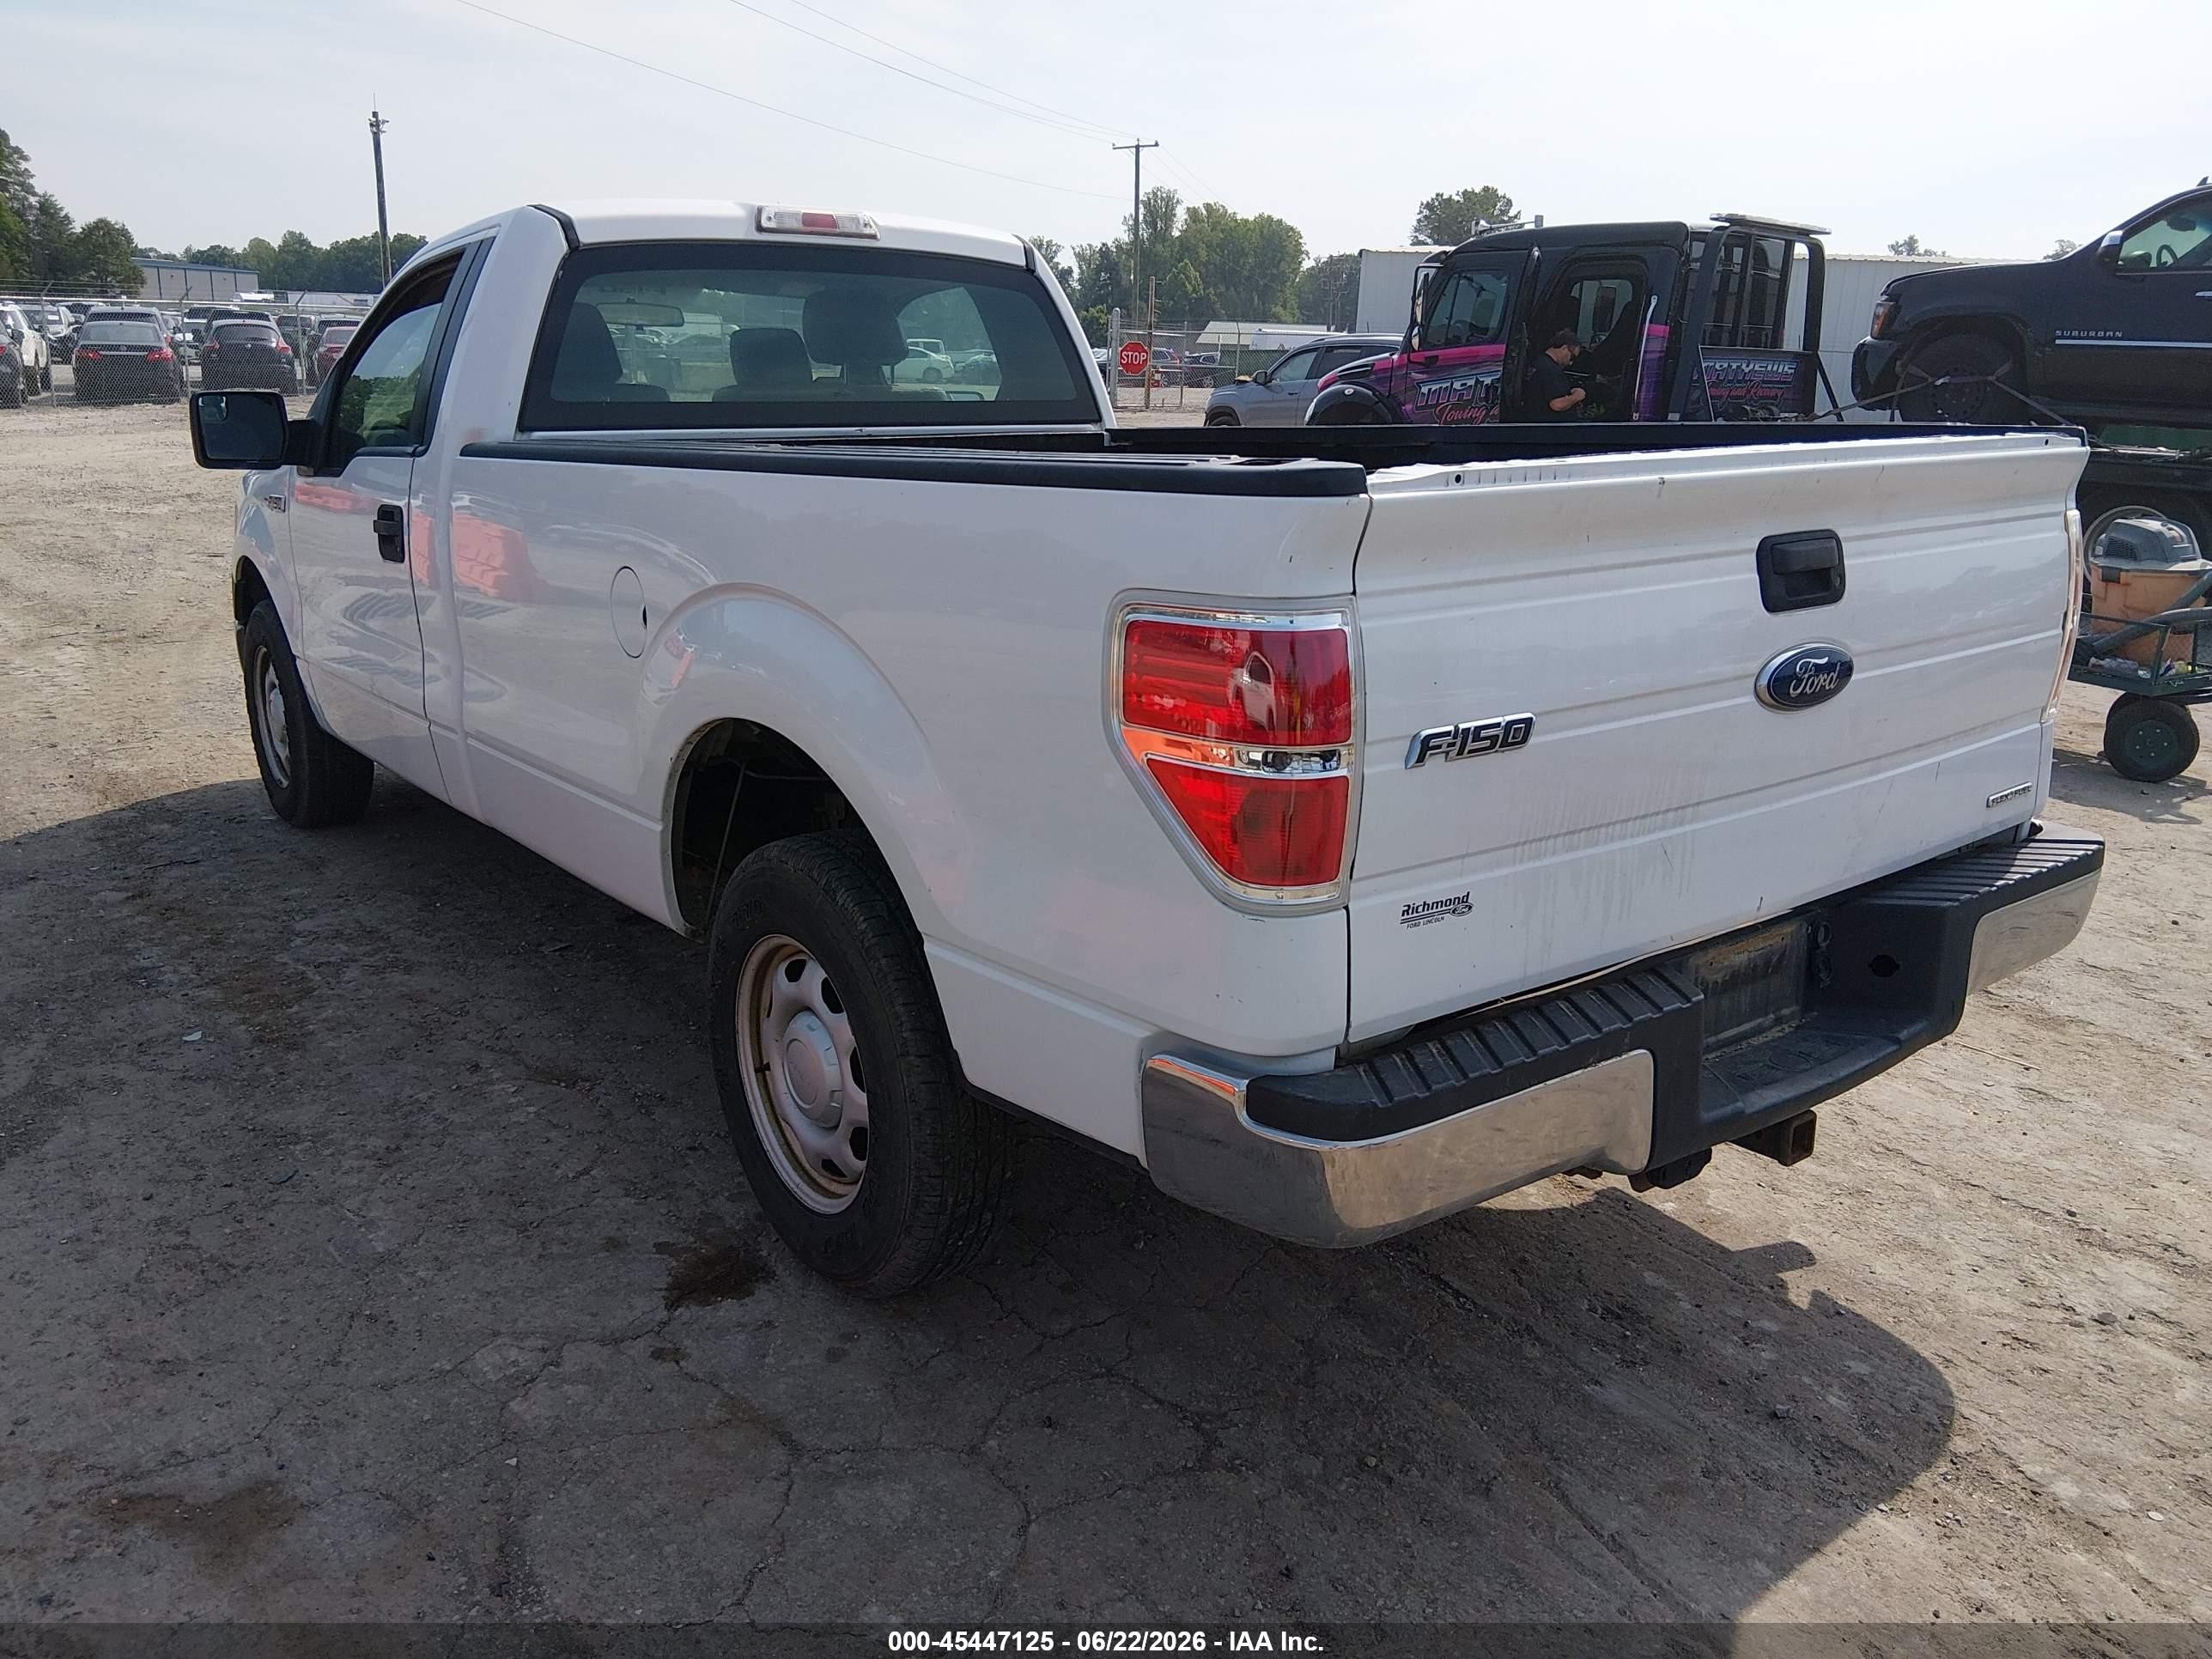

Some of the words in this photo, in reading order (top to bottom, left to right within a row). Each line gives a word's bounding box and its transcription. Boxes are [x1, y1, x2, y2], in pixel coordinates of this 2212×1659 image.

[1121, 351, 1147, 365] STOP
[1790, 656, 1840, 697] Ford
[1405, 712, 1535, 769] F-150
[1401, 891, 1470, 917] Richmond
[1407, 921, 1421, 929] FORD
[1422, 915, 1445, 926] LINCOLN
